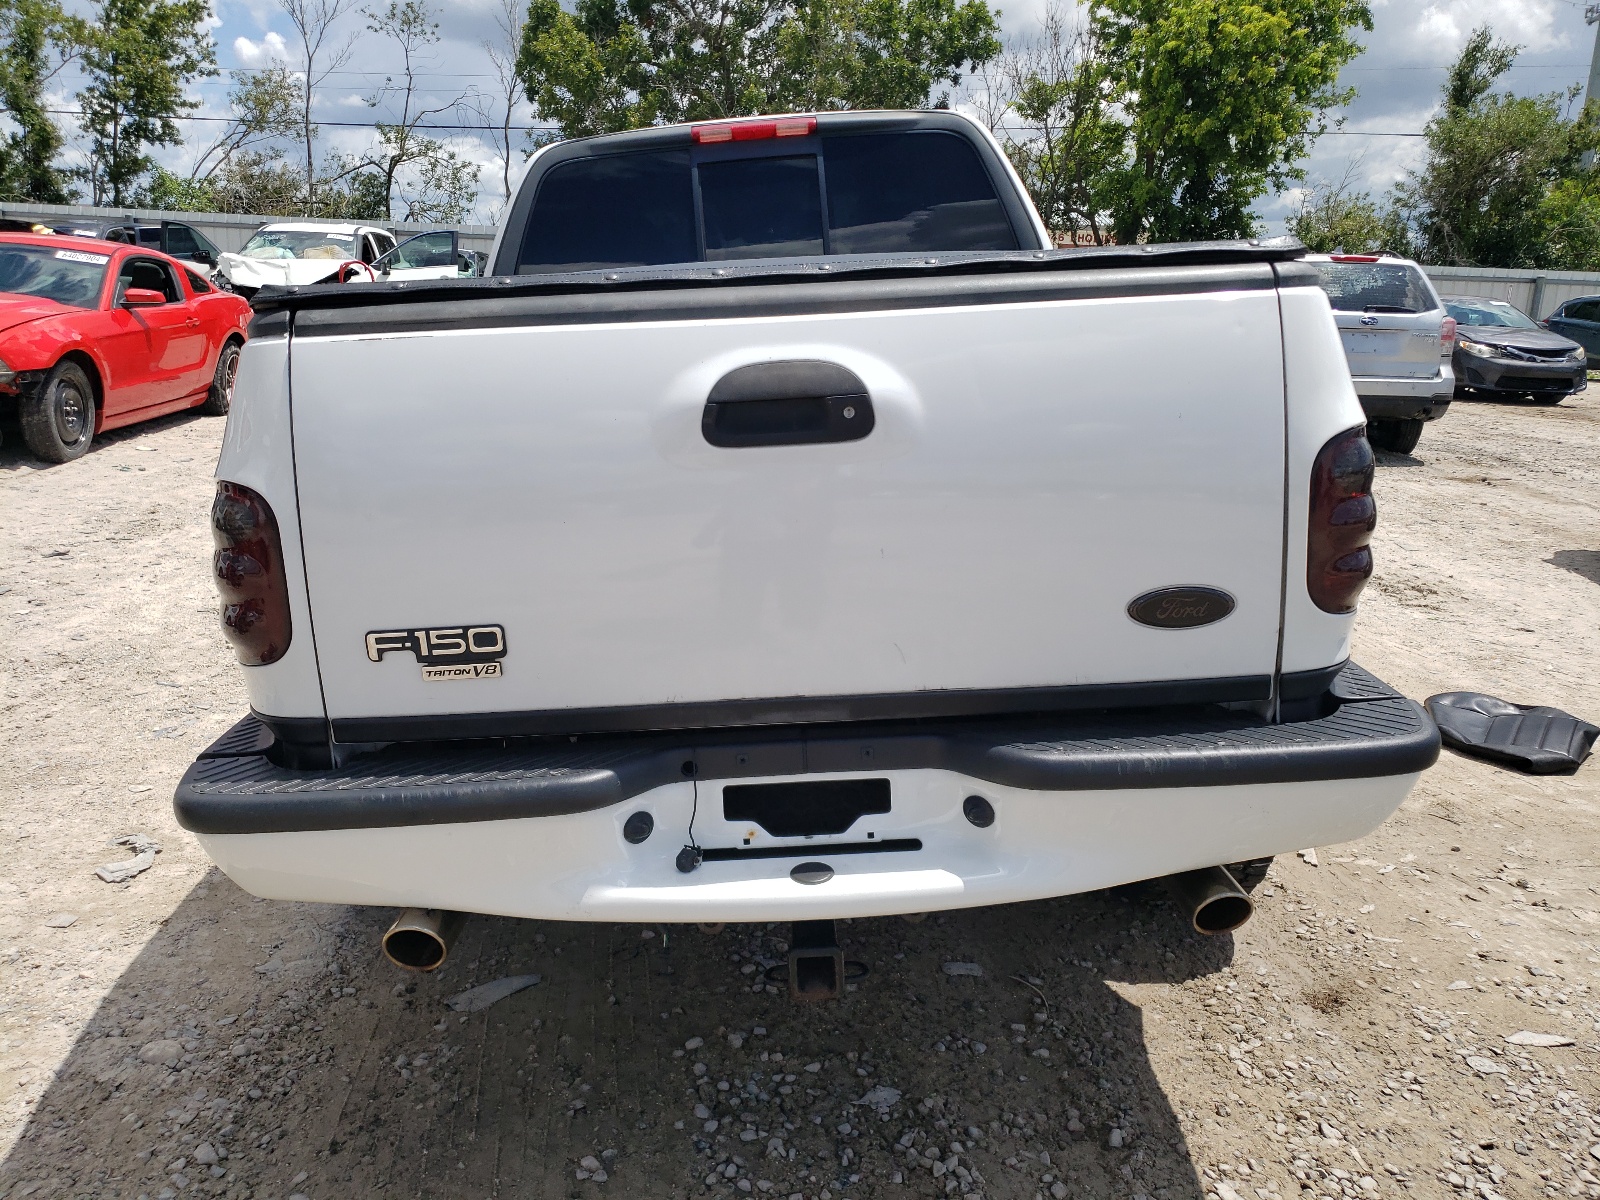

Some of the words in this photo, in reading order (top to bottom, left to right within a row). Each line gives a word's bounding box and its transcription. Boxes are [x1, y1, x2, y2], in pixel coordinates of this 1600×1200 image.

[1156, 597, 1209, 619] Ford
[366, 626, 504, 661] F-150
[425, 668, 471, 678] TRITON
[472, 664, 498, 678] V8
